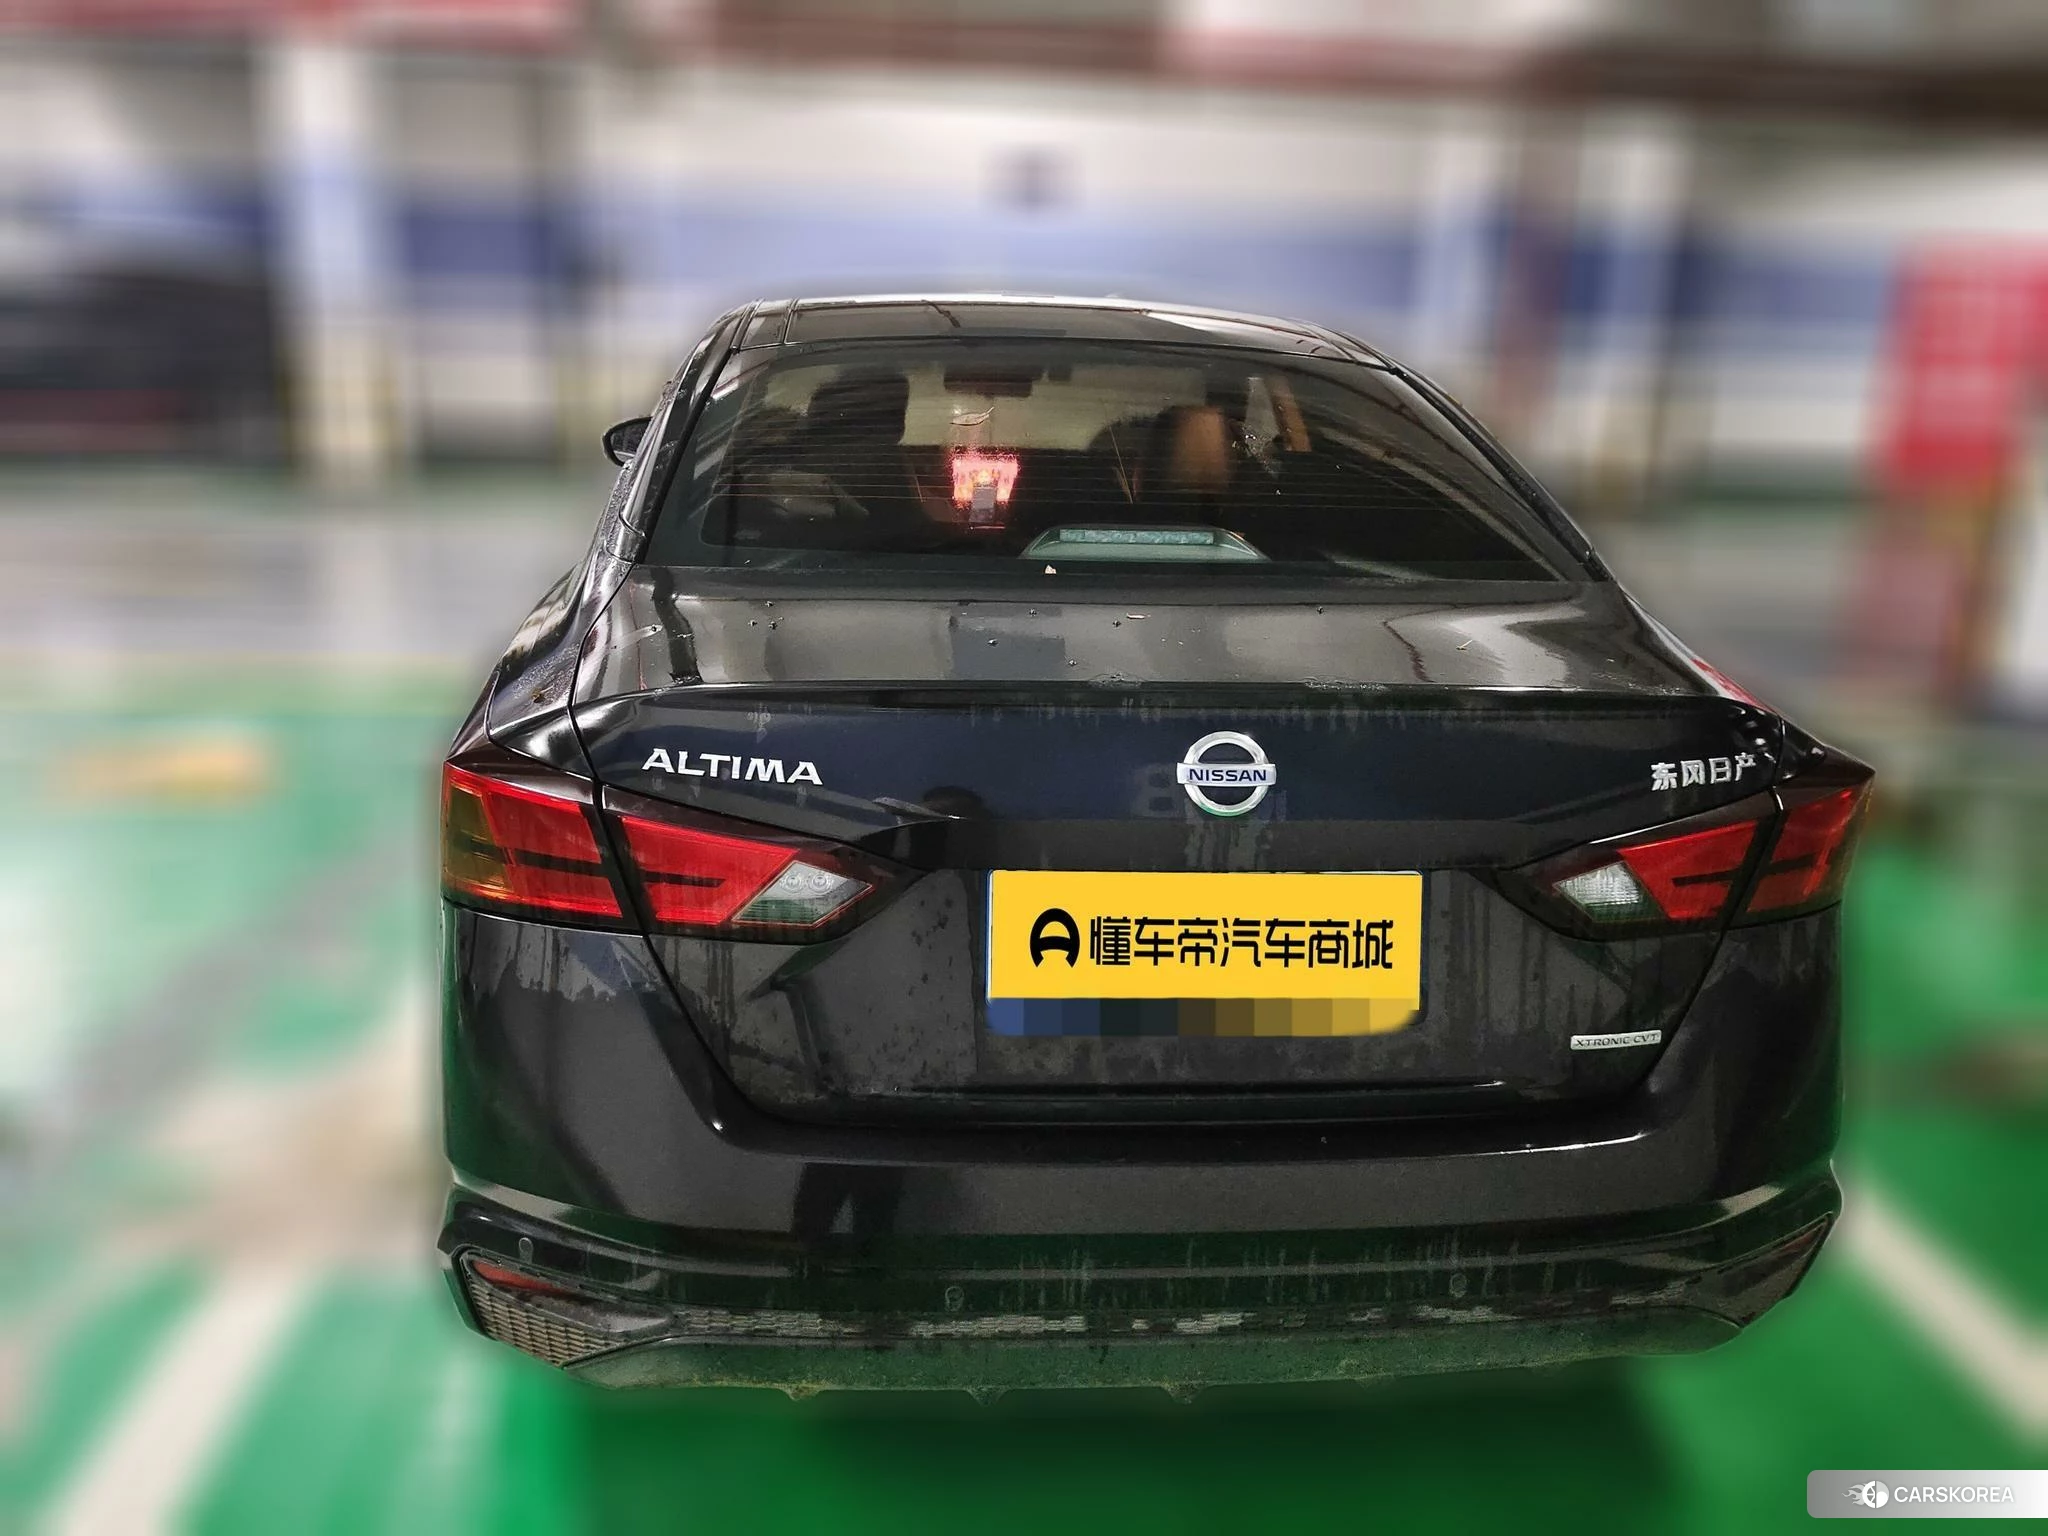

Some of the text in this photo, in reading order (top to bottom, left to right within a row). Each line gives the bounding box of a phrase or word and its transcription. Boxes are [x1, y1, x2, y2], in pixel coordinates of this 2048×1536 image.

[642, 748, 823, 785] ALTIMA
[1189, 768, 1267, 782] NISSAN
[1651, 752, 1756, 791] 东风日产
[1576, 1033, 1659, 1047] XTRONIC CVT
